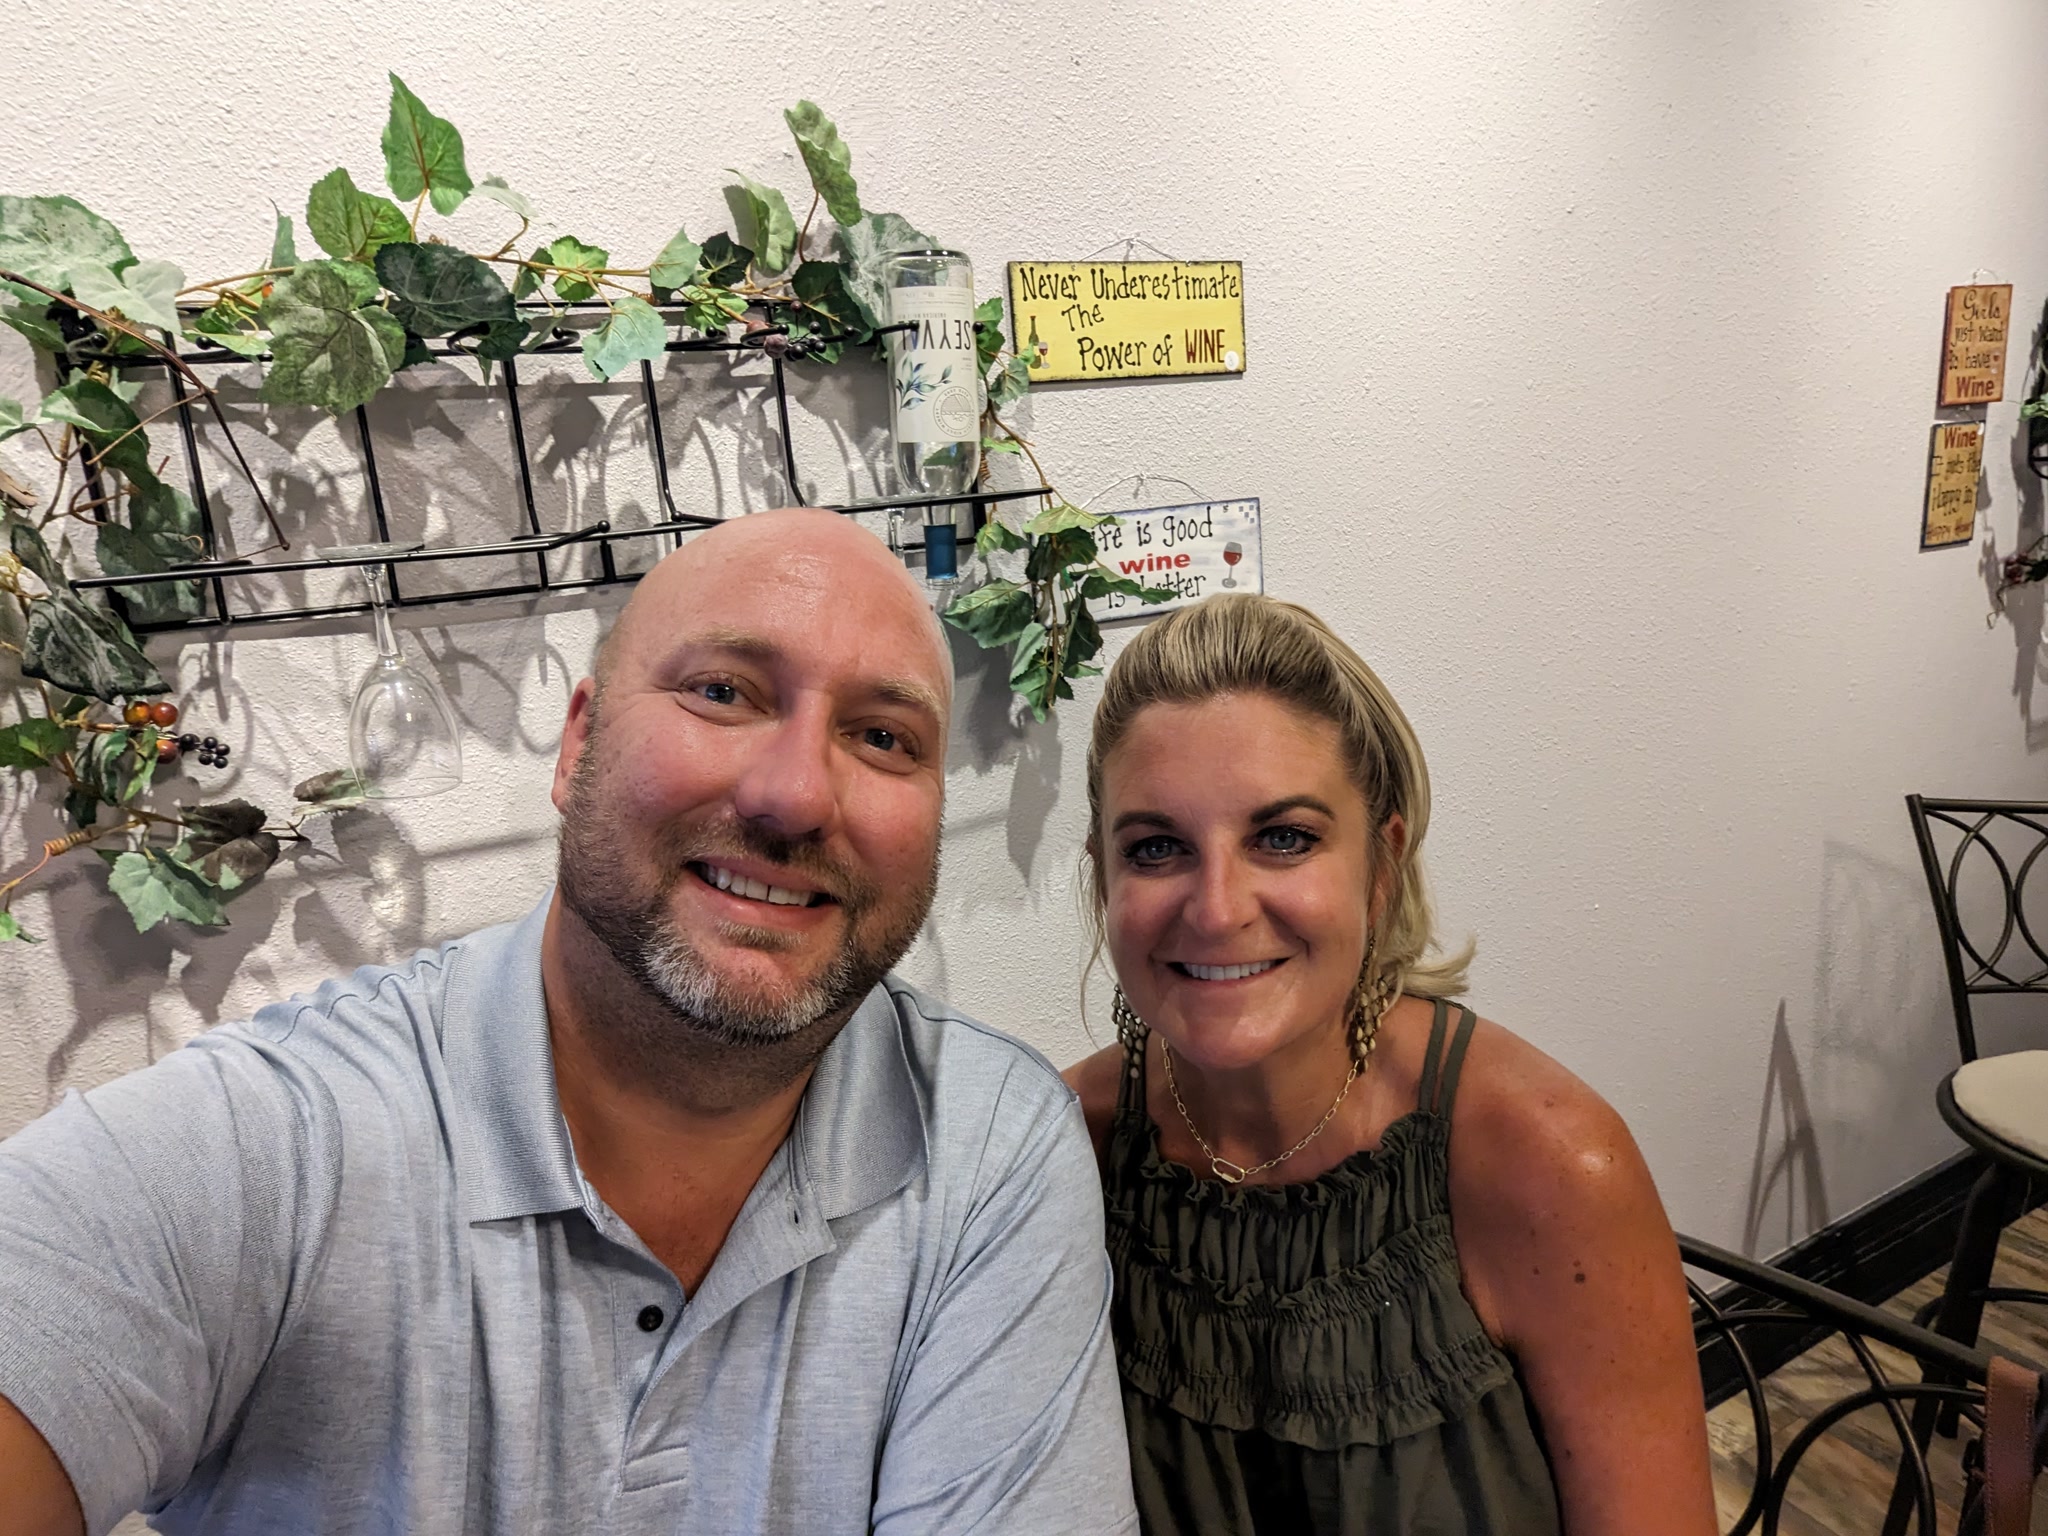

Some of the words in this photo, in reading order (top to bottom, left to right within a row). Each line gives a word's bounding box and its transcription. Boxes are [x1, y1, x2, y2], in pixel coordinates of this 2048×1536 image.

[1019, 266, 1081, 301] Never
[1090, 265, 1240, 300] Underestimate
[1061, 303, 1105, 331] The
[1961, 289, 2001, 321] Girls
[1077, 336, 1147, 371] Power
[1152, 334, 1173, 366] of
[1185, 328, 1226, 363] WINE
[1956, 376, 1995, 398] Wine
[1944, 427, 1977, 449] Wine
[1092, 523, 1122, 552] ife
[1137, 520, 1152, 546] is
[1163, 506, 1213, 547] good
[1119, 553, 1191, 575] wine
